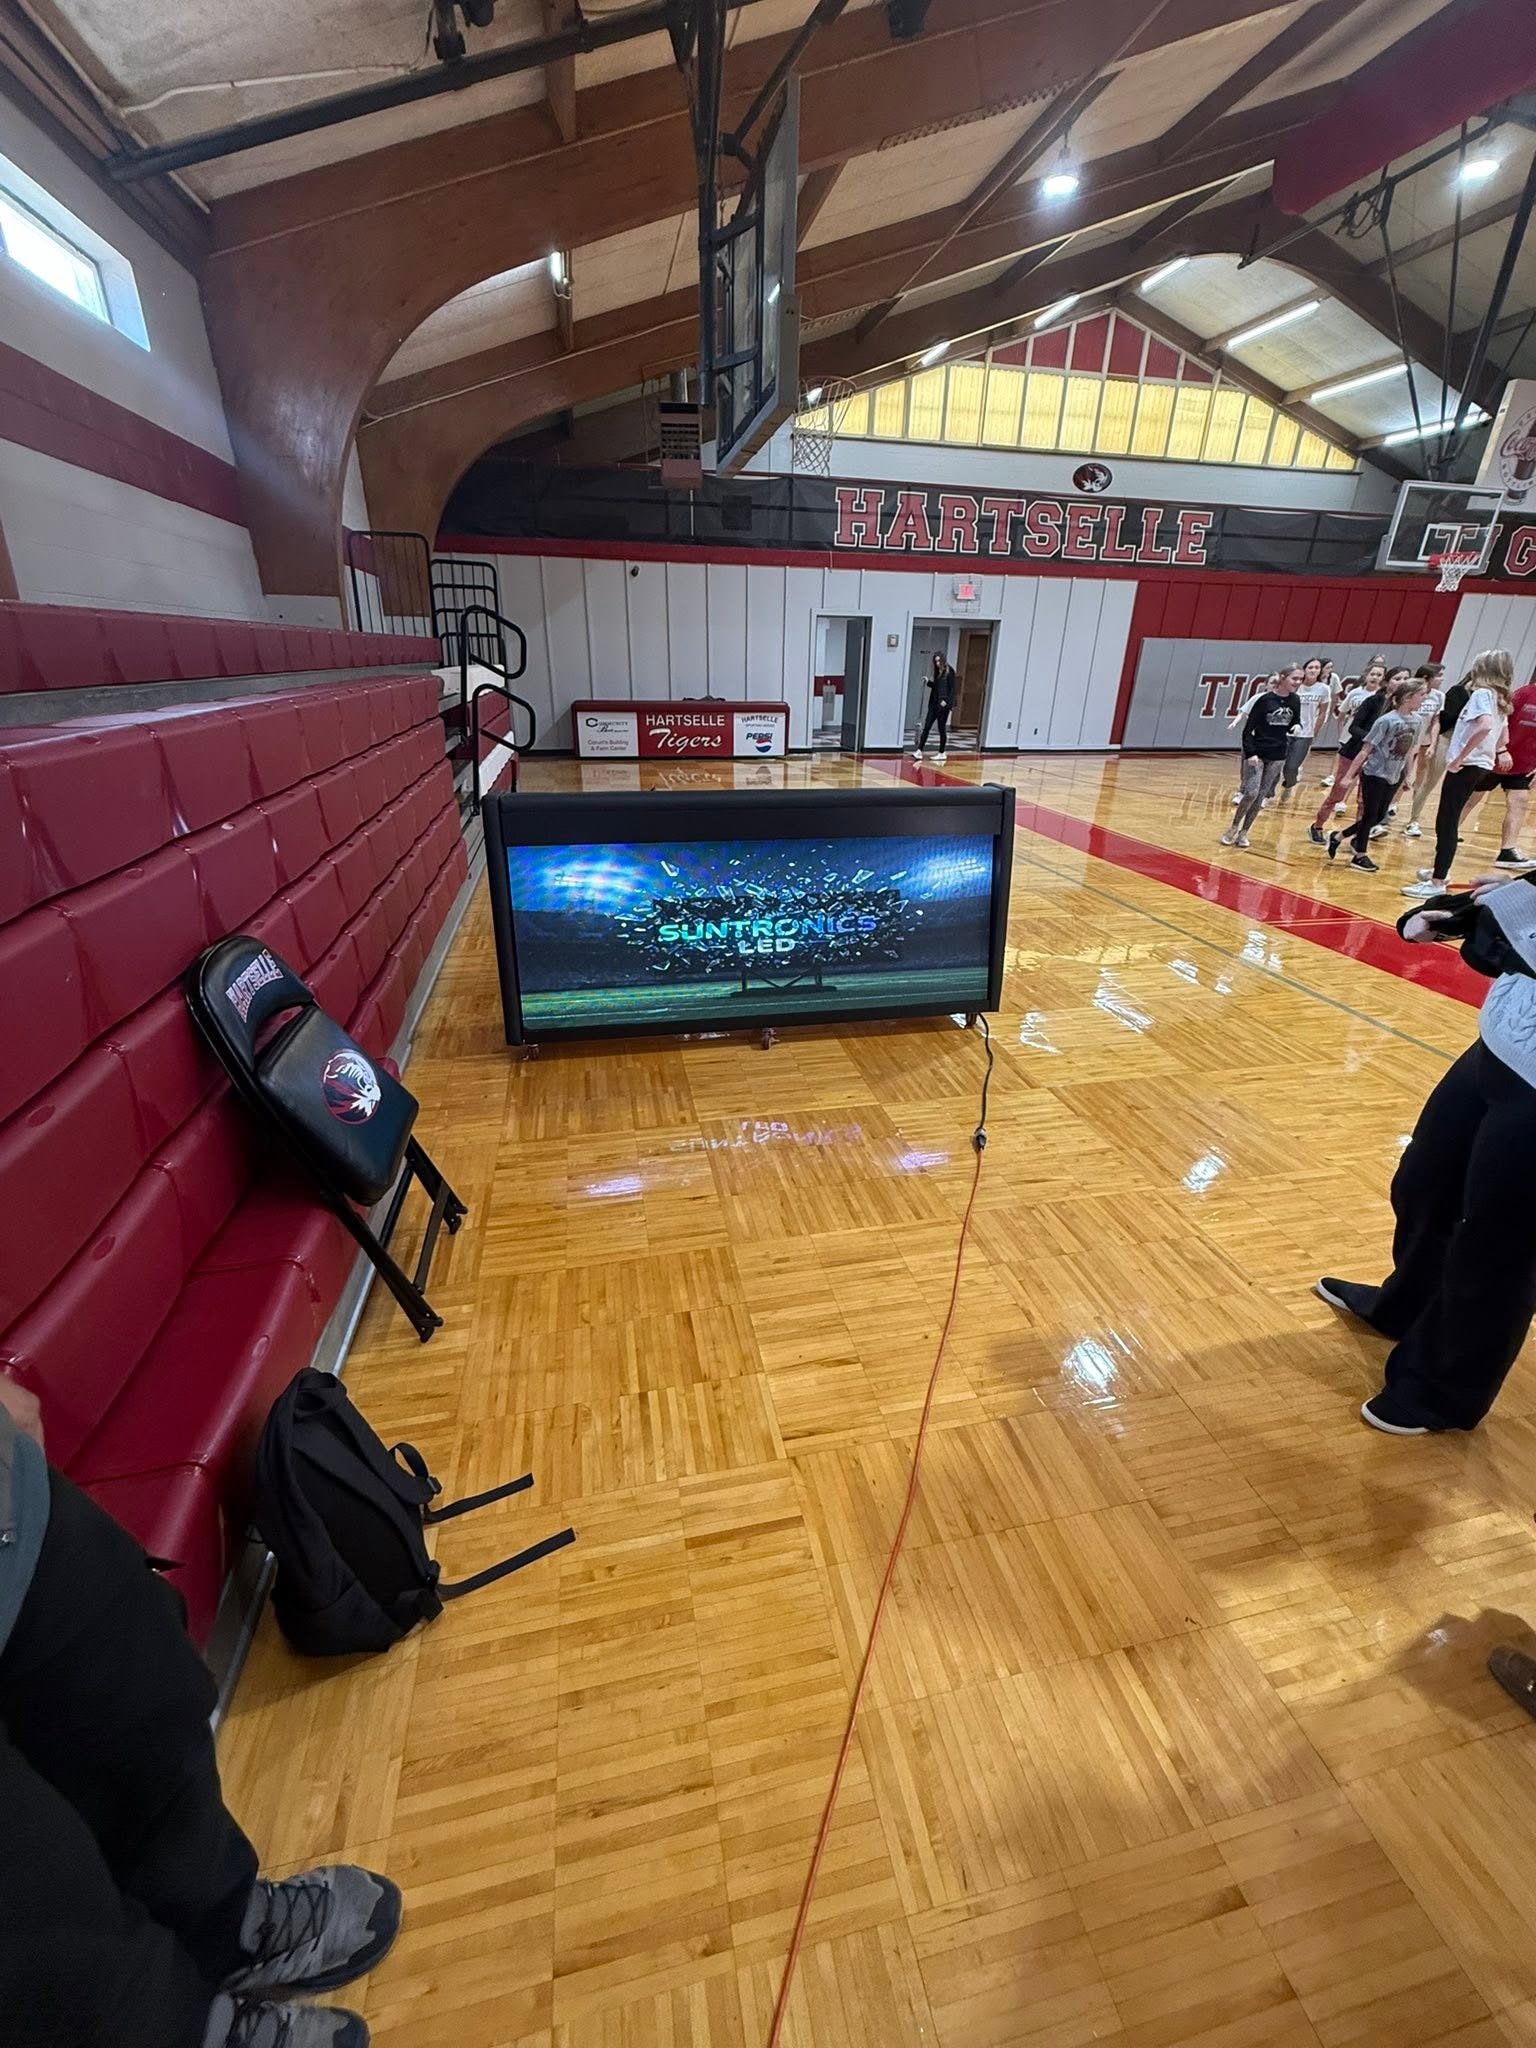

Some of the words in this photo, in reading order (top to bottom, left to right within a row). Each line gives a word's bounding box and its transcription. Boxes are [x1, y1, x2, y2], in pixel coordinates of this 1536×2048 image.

[834, 487, 1213, 565] HARTSELLE
[646, 714, 725, 726] HARTSELLE
[741, 714, 778, 724] HARTSELLE
[649, 728, 722, 754] Tigers
[745, 732, 773, 741] PEPSI
[658, 912, 878, 942] SUNTRONICS
[738, 938, 796, 954] LED
[225, 948, 284, 1024] HARTSELLE
